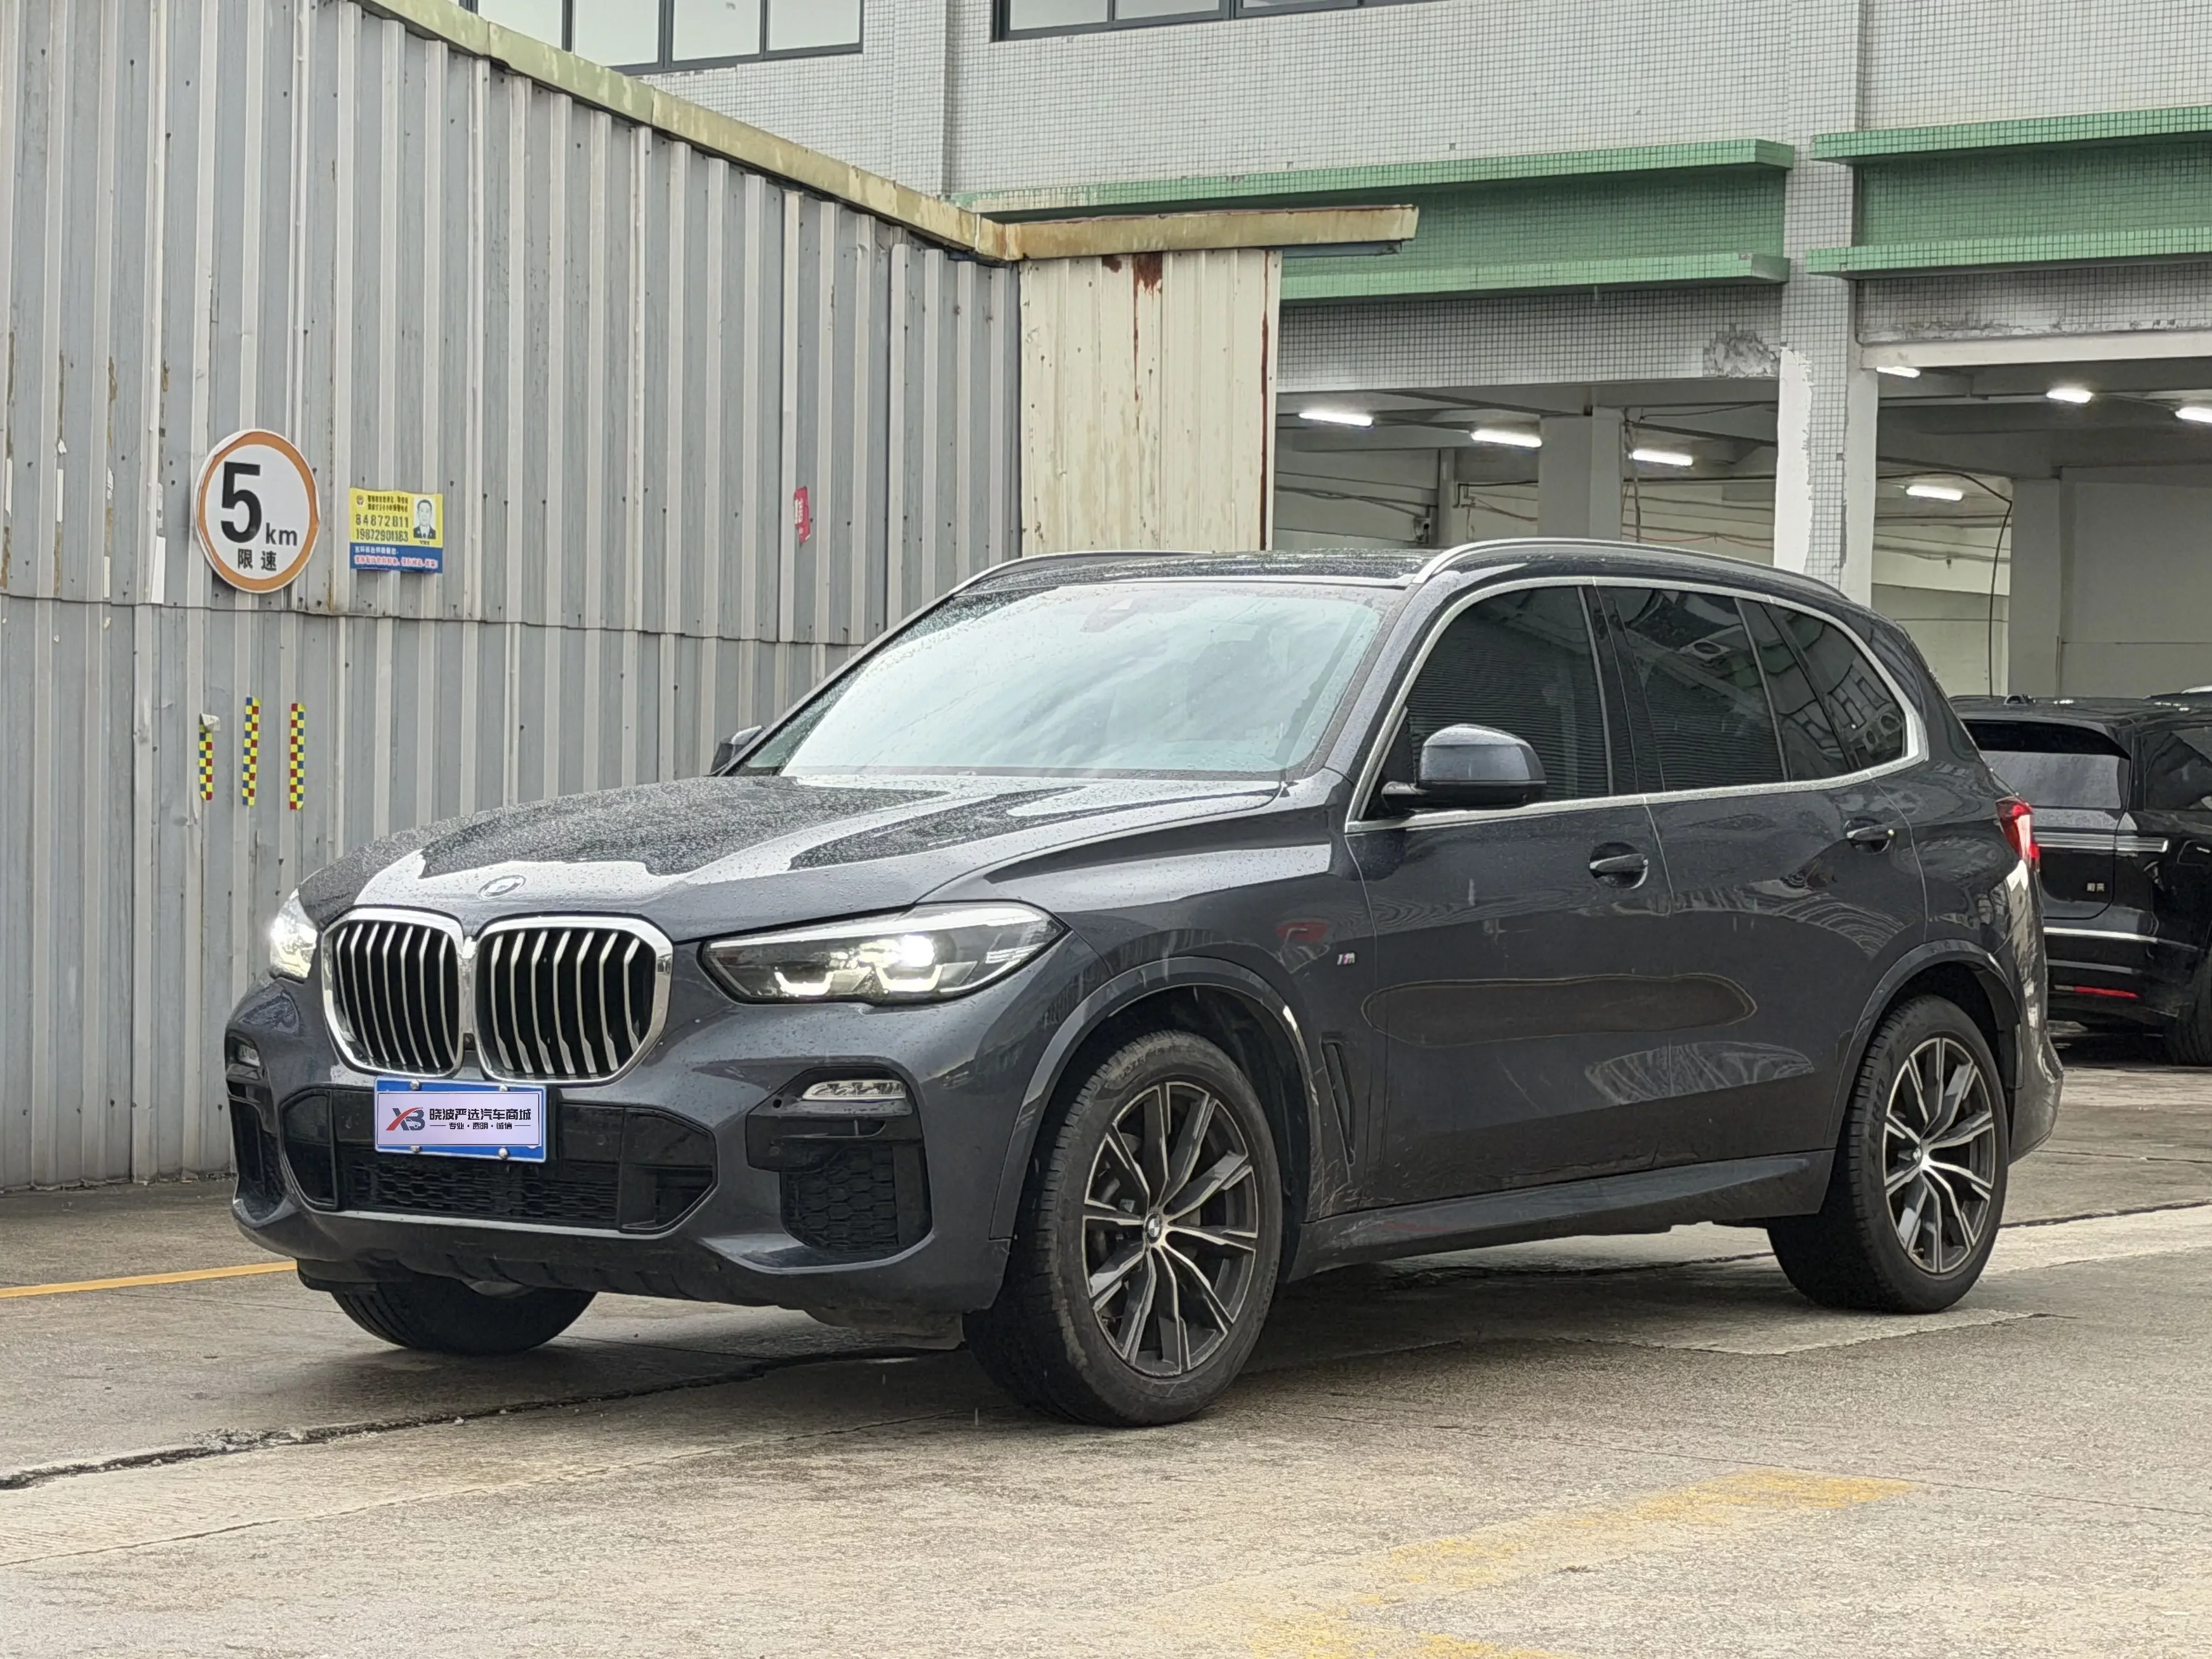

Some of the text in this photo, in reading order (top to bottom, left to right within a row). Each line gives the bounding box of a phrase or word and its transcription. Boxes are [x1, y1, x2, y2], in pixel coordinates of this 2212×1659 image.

[430, 1108, 531, 1120] 晓波严选汽车商城
